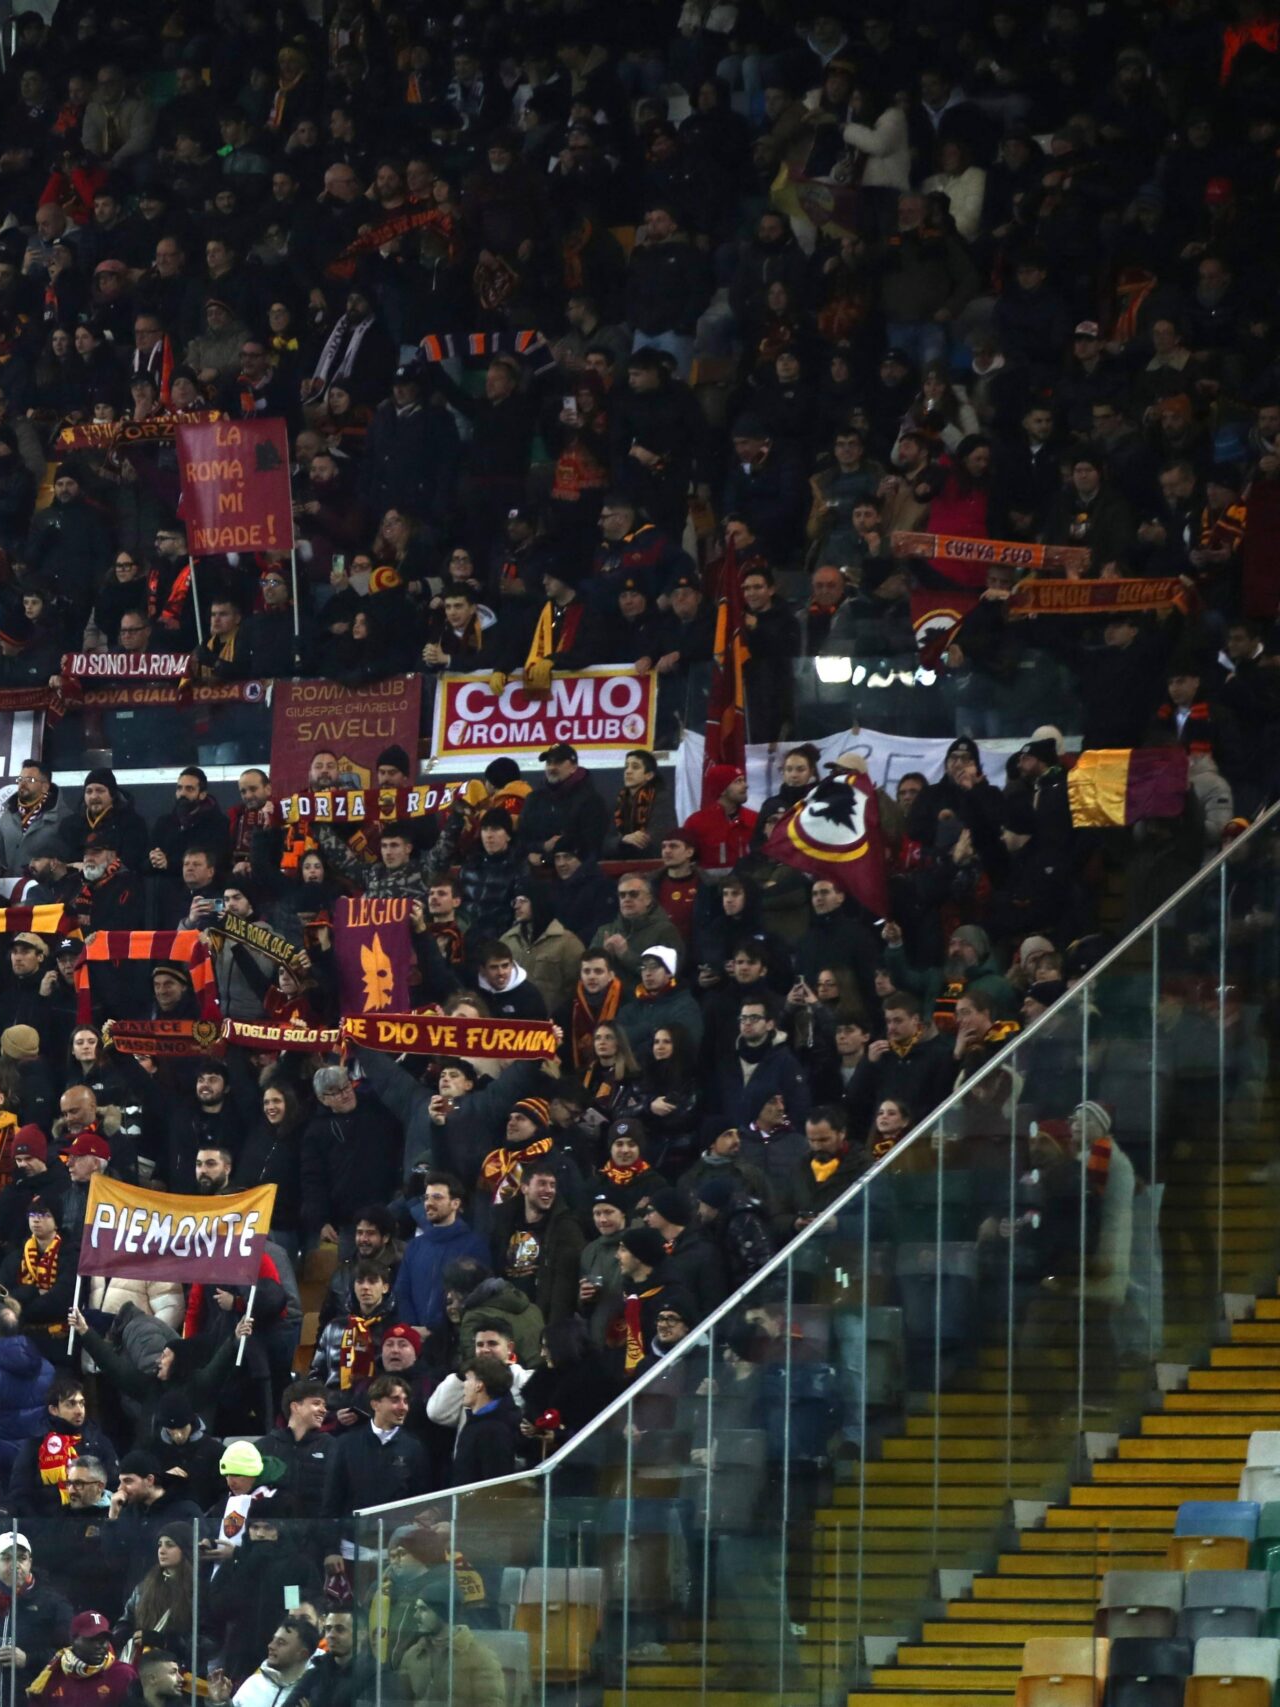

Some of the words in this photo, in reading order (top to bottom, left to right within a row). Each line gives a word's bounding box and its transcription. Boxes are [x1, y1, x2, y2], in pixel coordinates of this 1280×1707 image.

[216, 426, 241, 445] LA
[186, 459, 244, 483] ROMA
[944, 540, 994, 560] CURVA
[1001, 547, 1032, 563] SUD
[72, 654, 87, 674] IO
[88, 654, 128, 675] SONO
[129, 655, 147, 675] LA
[150, 655, 190, 676] ROMA
[77, 688, 130, 706] DOVA
[291, 682, 352, 701] ROMA
[455, 676, 643, 722] COMO
[286, 705, 342, 718] GIUSEPPE
[345, 700, 408, 714] CHIARELLO
[297, 718, 396, 741] SAVELLI
[472, 720, 547, 745] ROMA
[555, 719, 620, 741] CLUB
[280, 796, 365, 821] FORZA
[224, 915, 246, 938] DAJE
[247, 925, 270, 950] ROMA
[271, 936, 295, 959] DAJE
[233, 1022, 281, 1043] VOGLIO
[283, 1029, 317, 1043] SOLO
[320, 1029, 340, 1043] ST
[376, 1021, 418, 1044] DIO
[427, 1025, 458, 1049] VE
[466, 1025, 556, 1054] FURMIN
[91, 1203, 260, 1257] PIEMONTE
